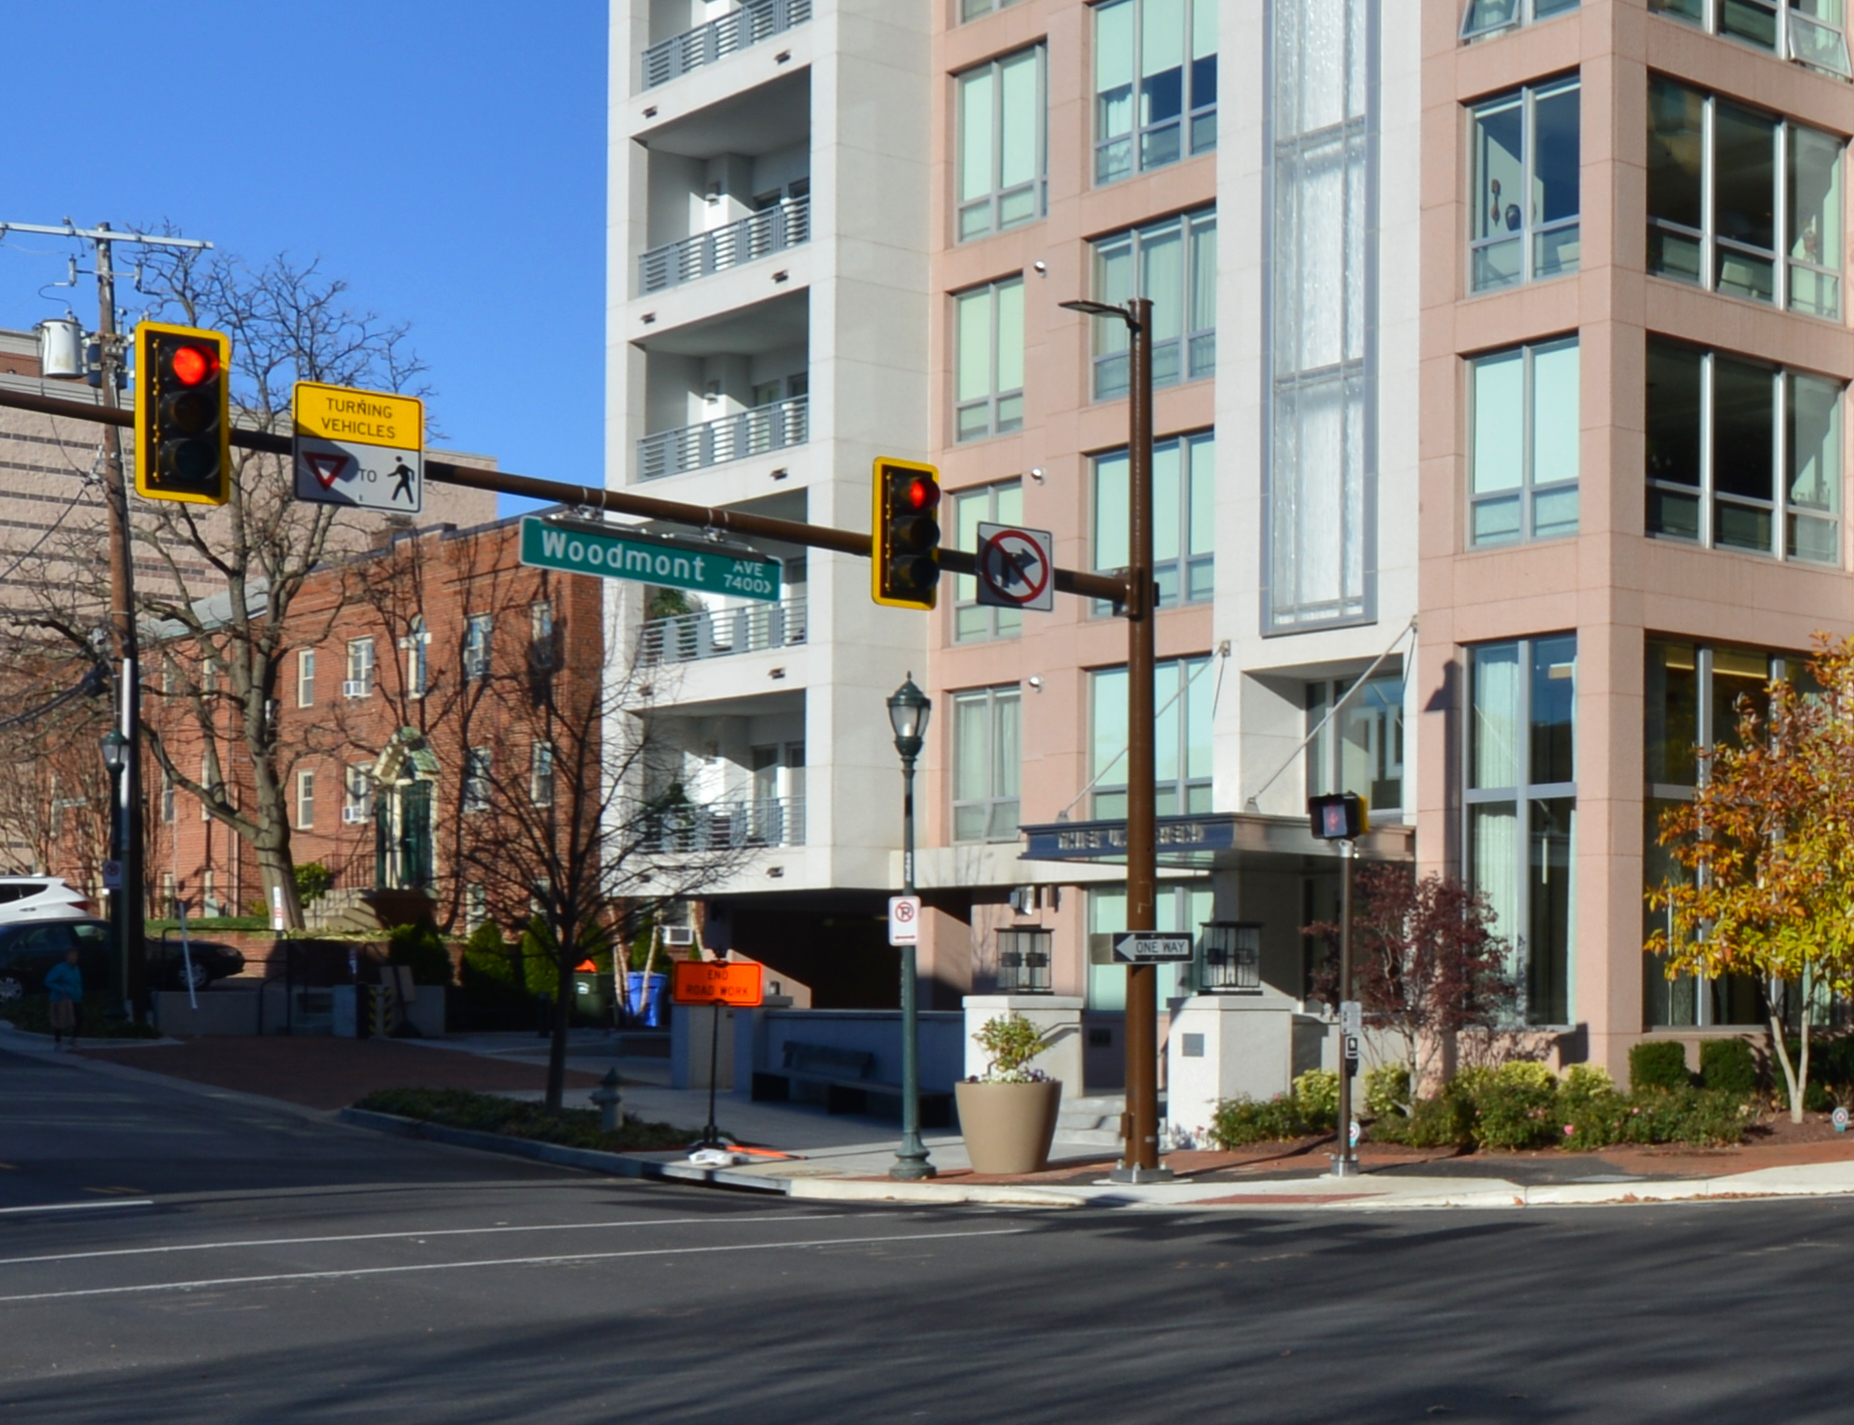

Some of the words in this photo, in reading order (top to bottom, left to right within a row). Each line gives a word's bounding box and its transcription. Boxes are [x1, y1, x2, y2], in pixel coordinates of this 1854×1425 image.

[326, 397, 393, 419] TURNING
[321, 417, 396, 440] VEHICLES
[359, 468, 378, 483] TO
[541, 529, 705, 583] Woodmont
[732, 560, 764, 577] AVE
[1136, 941, 1159, 954] ONE
[1162, 941, 1186, 954] WAY
[707, 969, 729, 981] END
